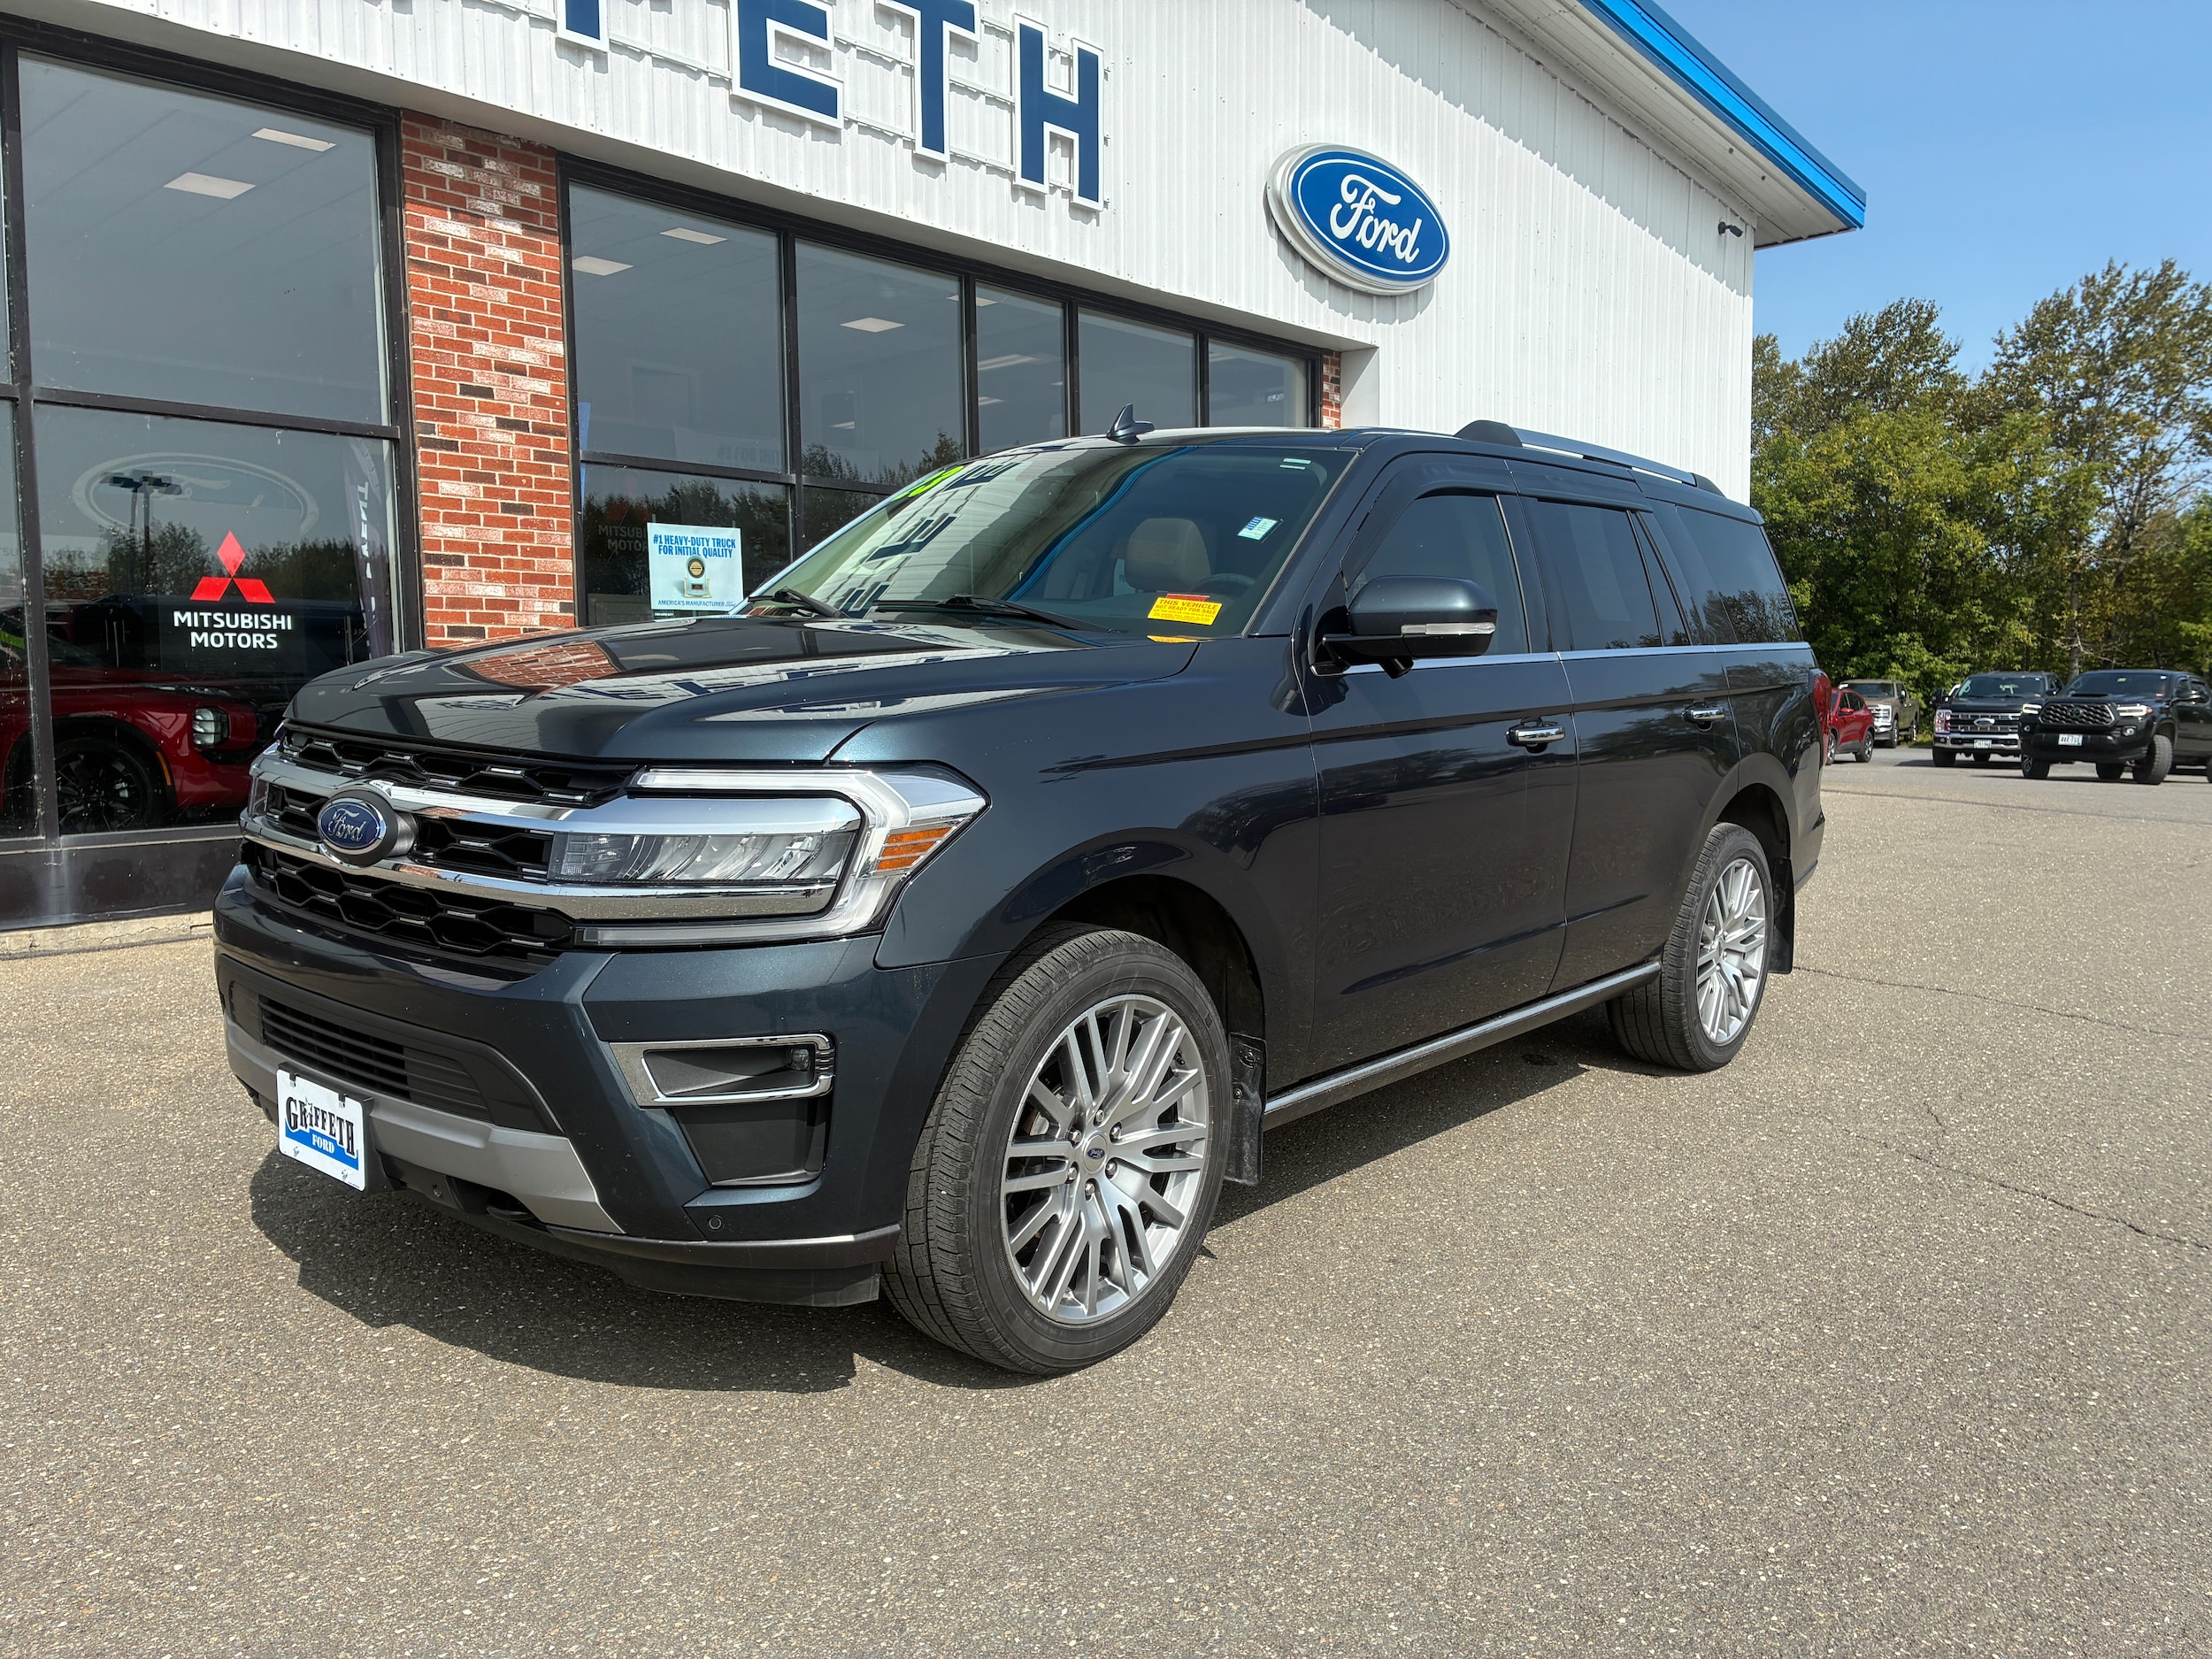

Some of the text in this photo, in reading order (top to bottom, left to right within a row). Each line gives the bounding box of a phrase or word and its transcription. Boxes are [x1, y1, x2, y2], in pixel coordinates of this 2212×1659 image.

[557, 0, 1103, 211] ETH
[1330, 173, 1423, 264] Ford
[597, 524, 648, 539] MITSUBI
[653, 534, 736, 549] #1 HEAVY-DUTY TRUCK
[658, 544, 733, 559] FOR INITIAL QUALITY
[1182, 601, 1219, 611] VEHICLE
[173, 611, 292, 631] MITSUBISHI
[190, 631, 278, 649] MOTORS
[328, 808, 366, 842] Ford
[286, 1096, 356, 1156] GRIFFETH
[311, 1133, 335, 1155] FORD
